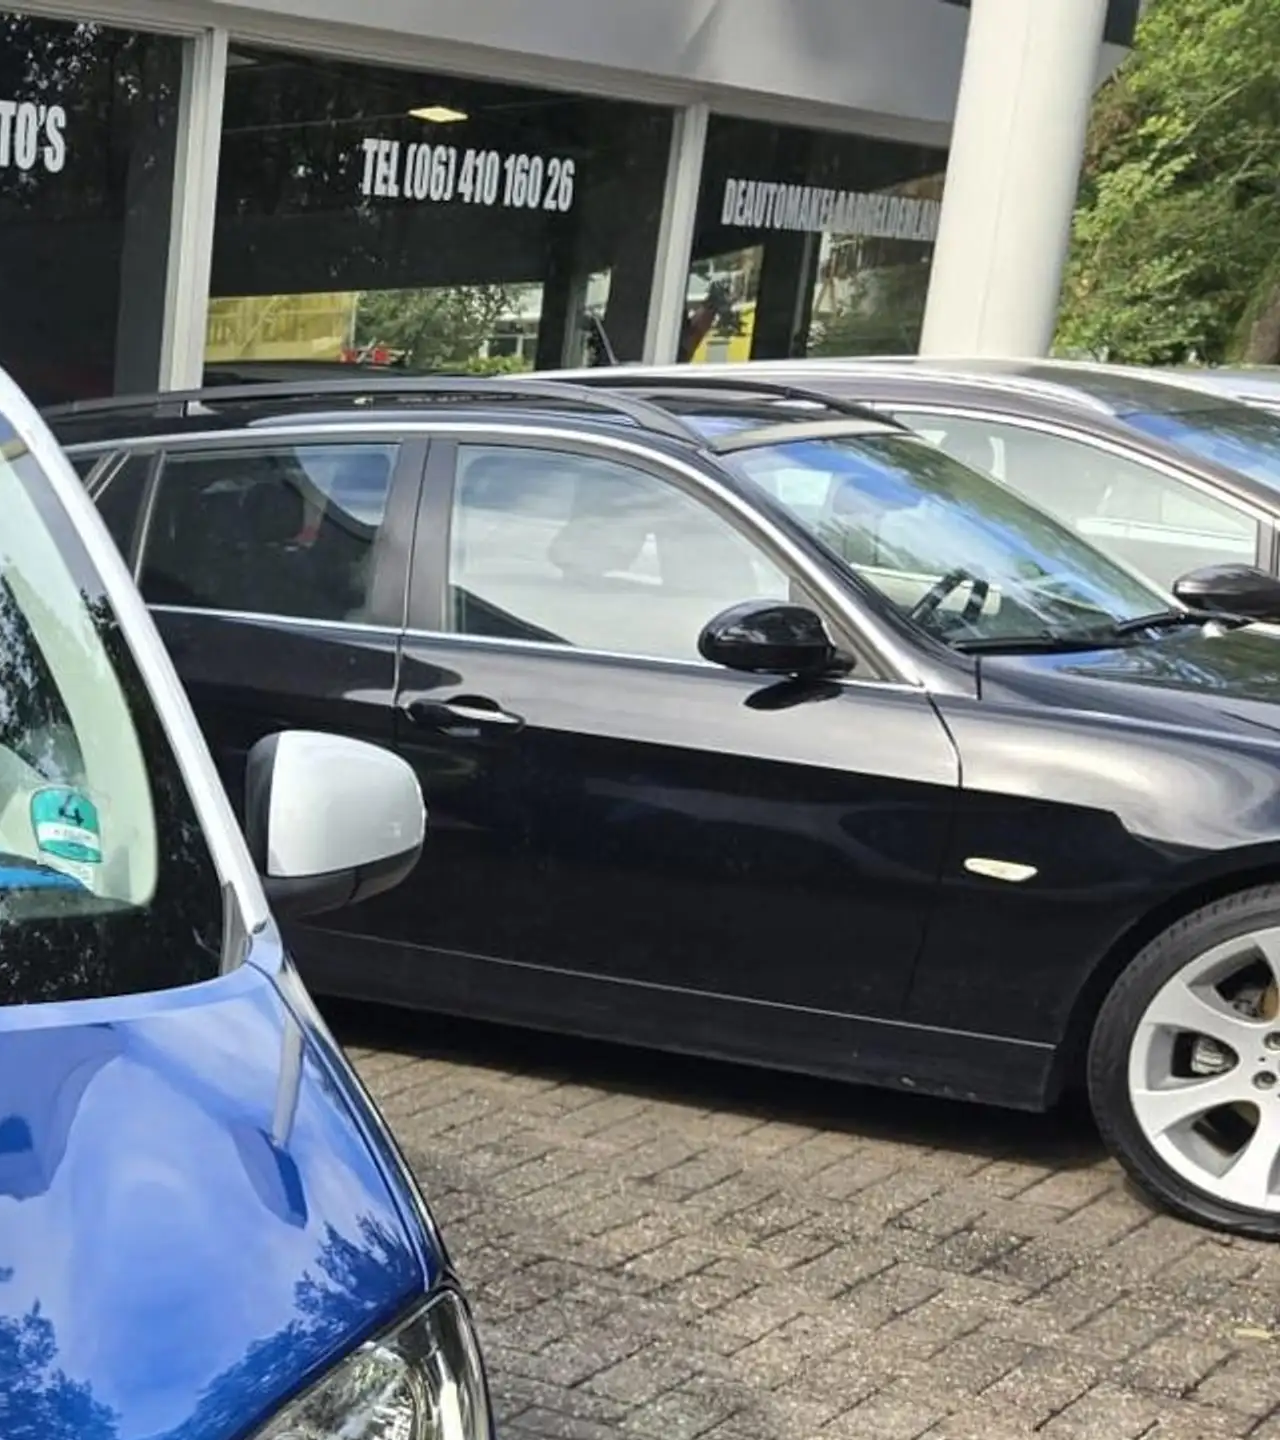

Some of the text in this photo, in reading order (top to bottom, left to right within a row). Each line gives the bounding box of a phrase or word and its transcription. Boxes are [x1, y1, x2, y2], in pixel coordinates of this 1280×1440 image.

[362, 138, 576, 212] TEL (06) 410 160 26
